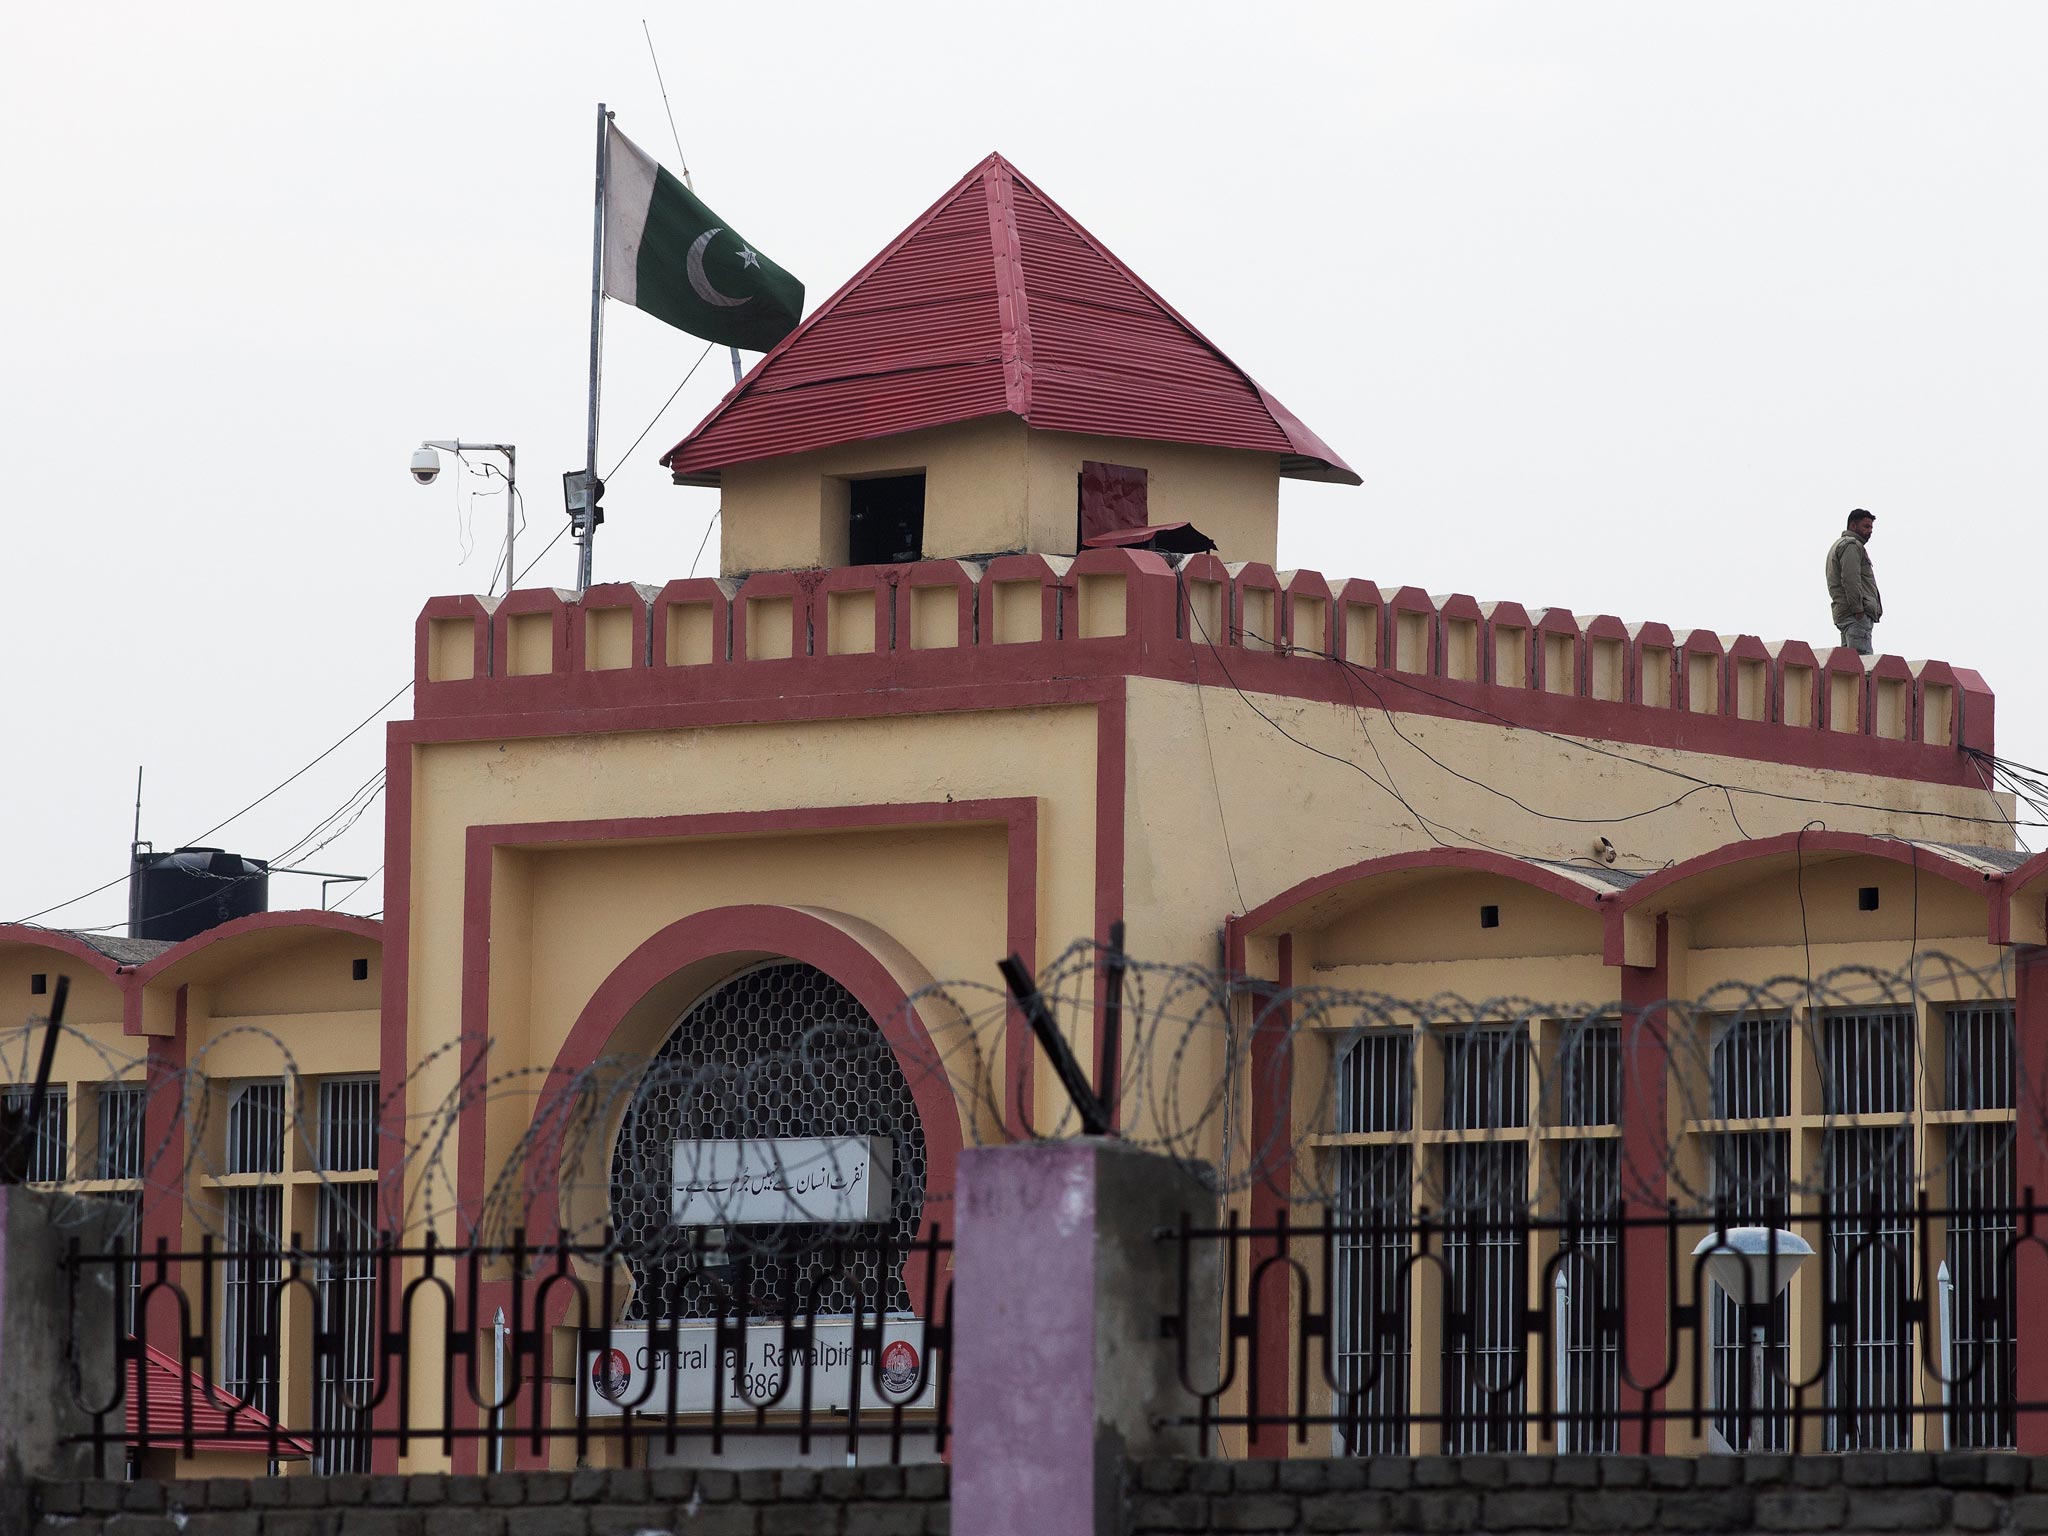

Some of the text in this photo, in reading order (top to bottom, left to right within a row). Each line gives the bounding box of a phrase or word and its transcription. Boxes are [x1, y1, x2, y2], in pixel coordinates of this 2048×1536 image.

[707, 1181, 729, 1192] سے
[751, 1162, 779, 1195] نہیں
[797, 1167, 830, 1194] انسان
[831, 1162, 864, 1196] نفرت
[636, 1344, 707, 1370] Central
[714, 1342, 754, 1373] al,
[730, 1373, 780, 1398] 1986
